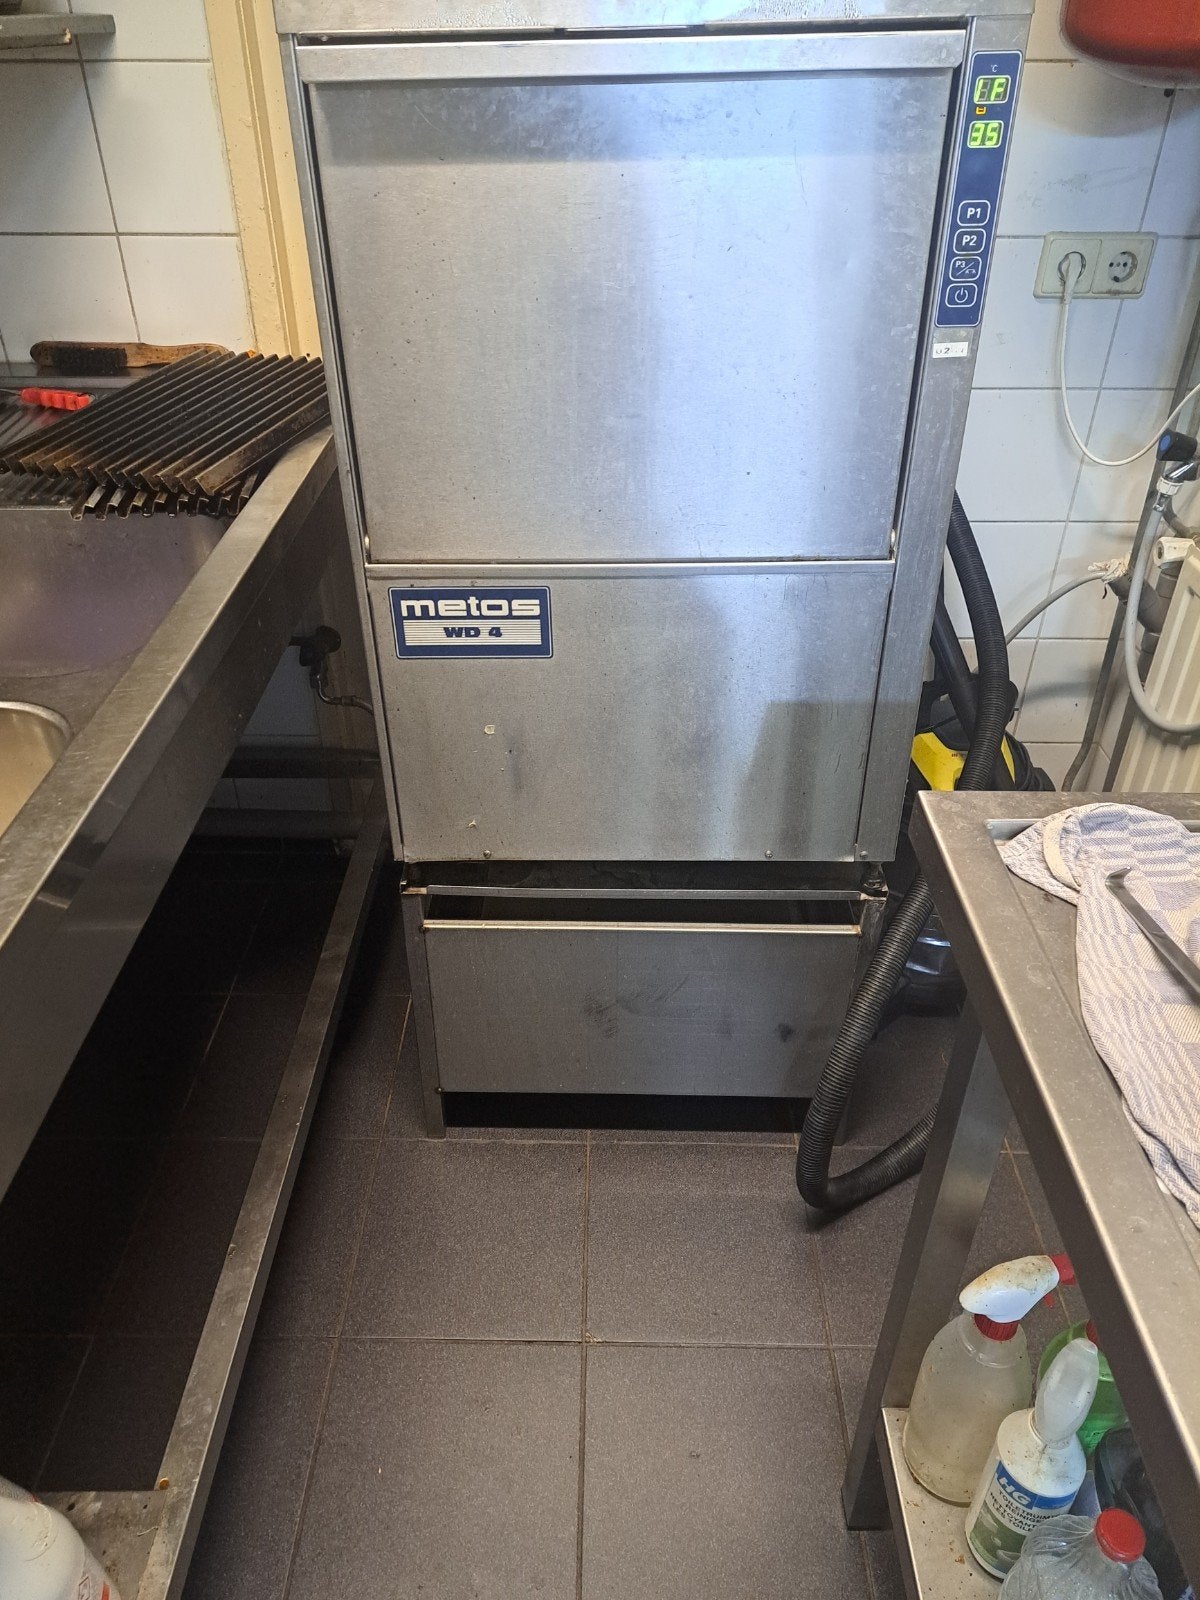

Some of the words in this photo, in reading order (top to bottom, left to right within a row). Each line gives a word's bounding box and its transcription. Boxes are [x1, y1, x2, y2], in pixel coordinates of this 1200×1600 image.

[970, 123, 999, 146] 35
[966, 207, 981, 219] P1
[962, 235, 977, 246] P2
[955, 260, 966, 268] P3
[400, 596, 541, 617] metos
[443, 626, 481, 638] WD
[488, 626, 503, 638] 4
[998, 1476, 1032, 1506] HG
[999, 1489, 1057, 1520] TOILETRUIM
